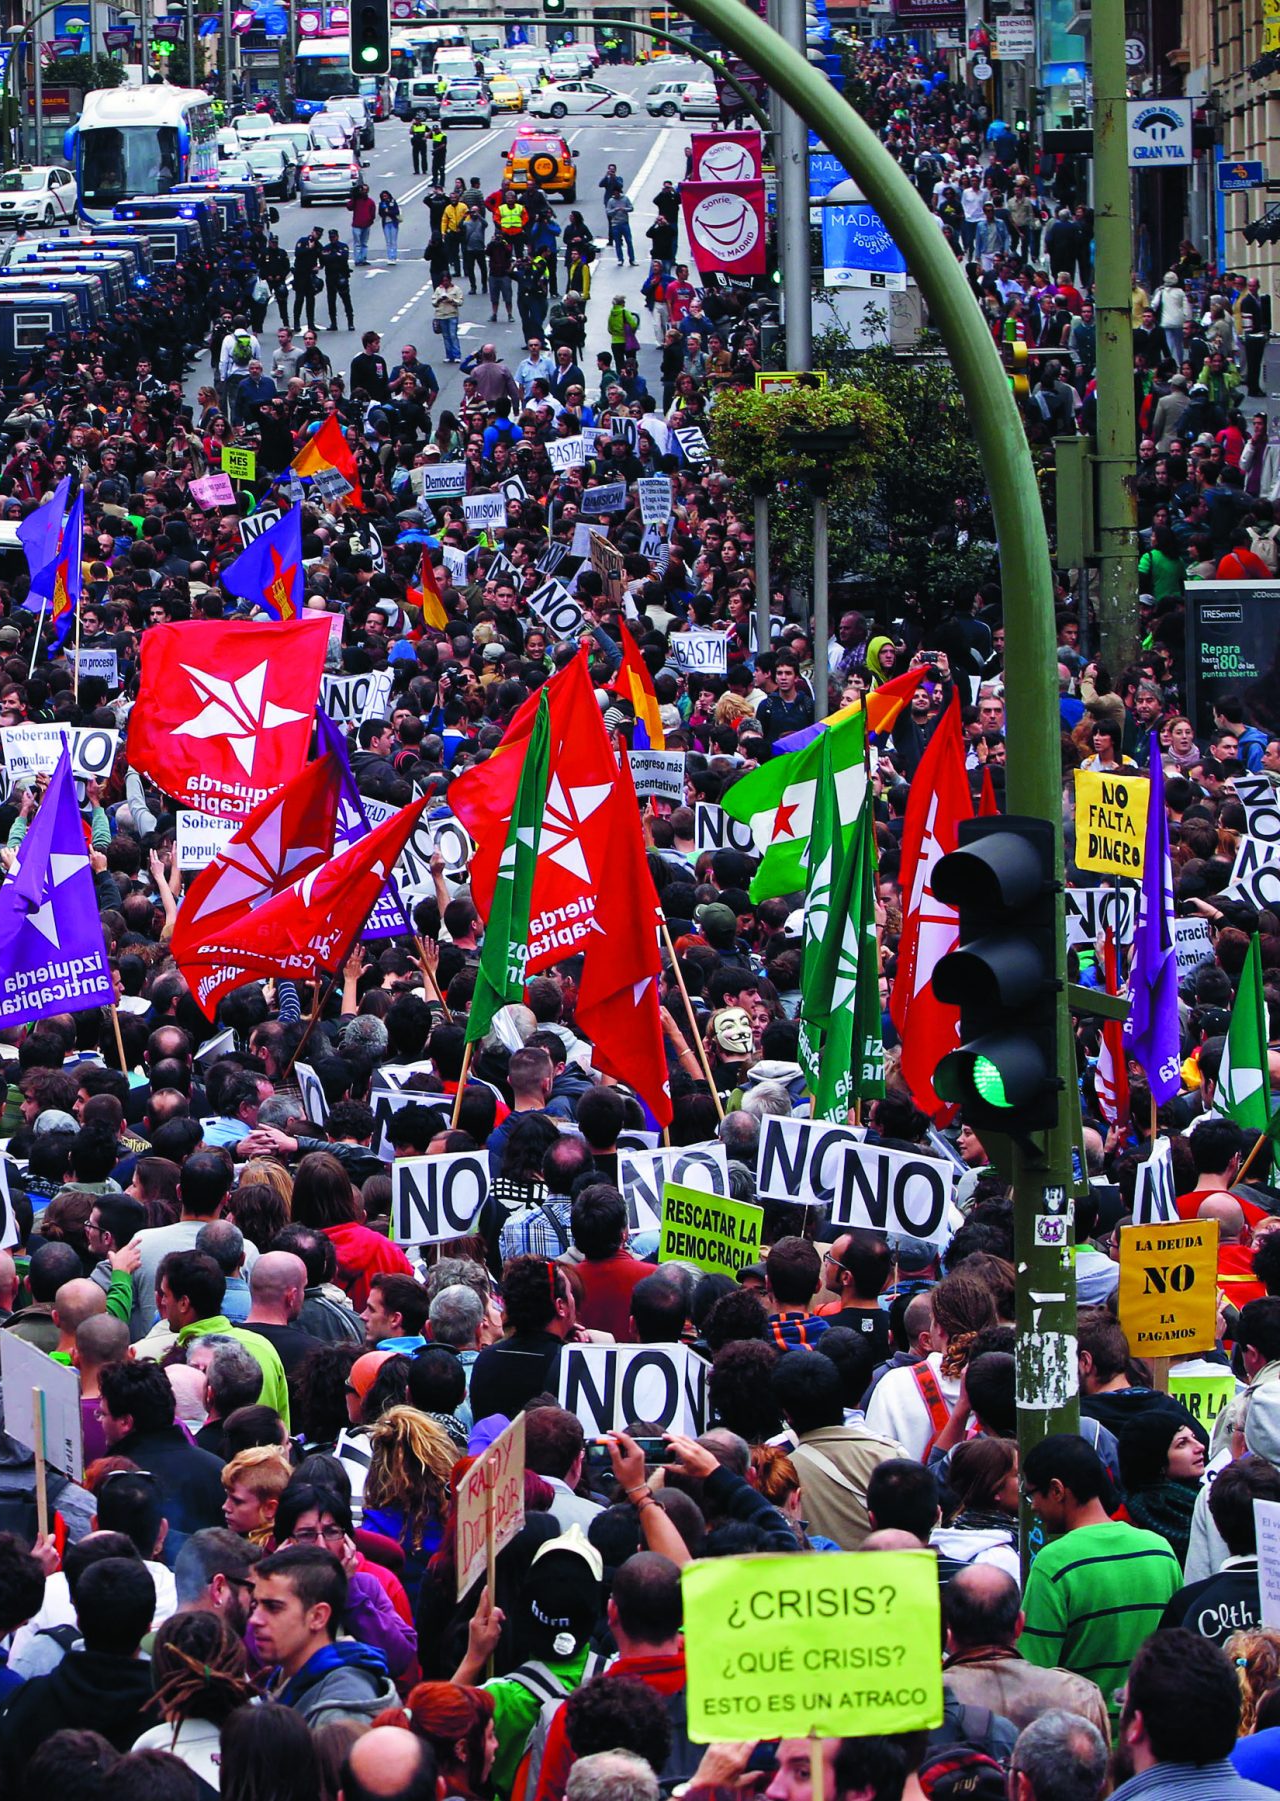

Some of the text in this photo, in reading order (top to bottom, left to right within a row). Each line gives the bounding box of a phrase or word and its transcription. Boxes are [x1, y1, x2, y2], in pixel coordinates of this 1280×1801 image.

[1132, 105, 1157, 129] CENTRO
[811, 161, 844, 171] MAD
[1133, 145, 1186, 160] GRAN VIA
[831, 214, 886, 228] MADR
[727, 231, 755, 257] MADRID
[230, 456, 248, 467] MES
[532, 581, 582, 634] NO
[1203, 610, 1240, 618] TRESemmé
[89, 655, 114, 669] proceso
[1201, 643, 1240, 656] Repara
[329, 681, 370, 717] NO
[667, 758, 683, 772] más
[1102, 781, 1129, 809] NO
[699, 806, 754, 850] NO
[1089, 804, 1137, 836] FALTA
[1088, 833, 1141, 867] DINERO
[1066, 890, 1129, 939] NO
[759, 1119, 858, 1201] NO
[399, 1157, 488, 1239] NO
[621, 1151, 725, 1230] NO
[838, 1147, 945, 1238] NO
[665, 1198, 757, 1247] RESCATAR LA
[666, 1230, 755, 1272] DEMOCRACIA
[1135, 1235, 1203, 1252] LA DEUDA
[1143, 1263, 1195, 1295] NO
[1137, 1327, 1196, 1342] PAGAMOS
[1160, 1314, 1175, 1324] LA
[565, 1350, 678, 1434] NO
[728, 1585, 896, 1629] ¿CRISIS?
[722, 1645, 907, 1680] ¿QUÉ CRISIS?
[704, 1688, 927, 1716] ESTO ES UN ATRACO
